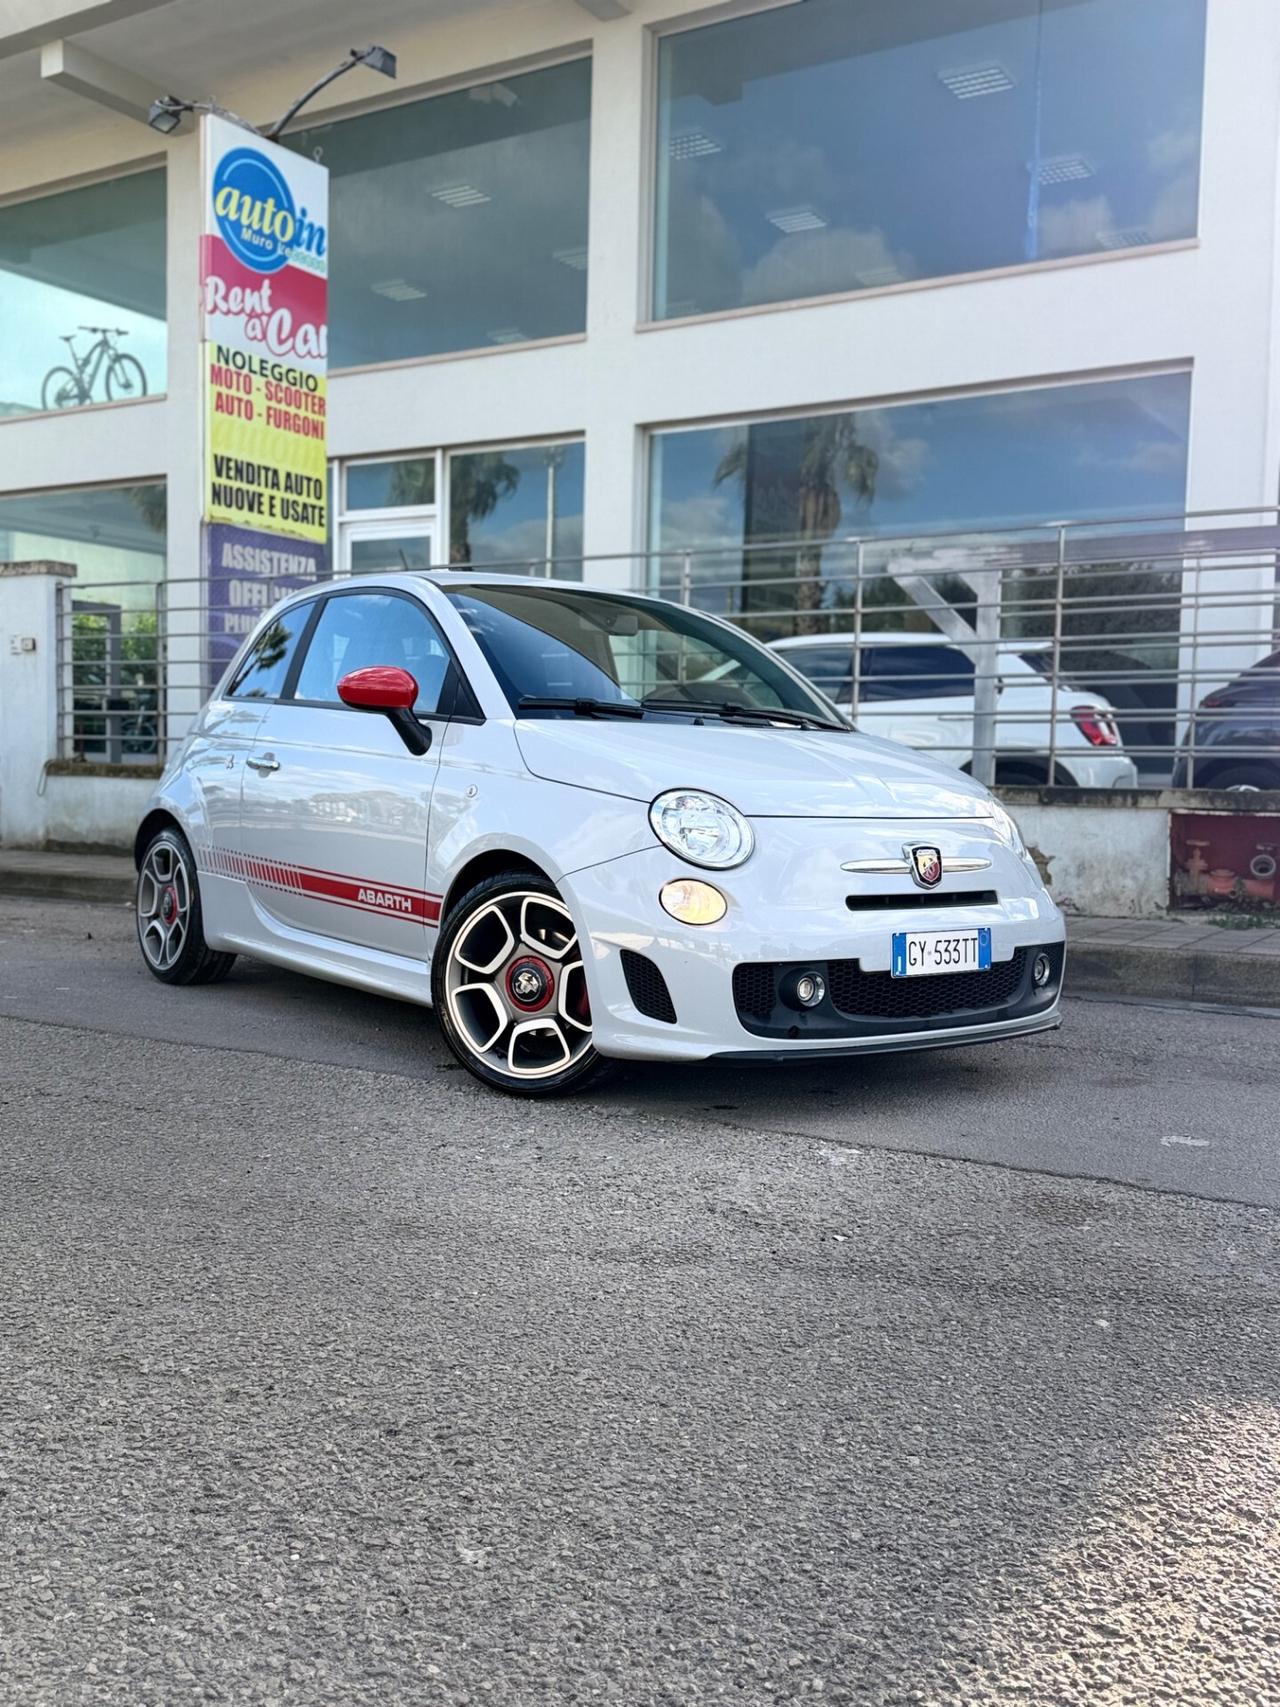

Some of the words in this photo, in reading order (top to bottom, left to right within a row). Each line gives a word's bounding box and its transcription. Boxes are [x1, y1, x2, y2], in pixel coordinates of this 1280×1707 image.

[241, 227, 273, 251] Muro
[206, 276, 272, 314] Rent
[216, 345, 318, 392] NOLEGGIO
[211, 364, 252, 395] MOTO
[265, 381, 326, 418] SCOOTER
[215, 392, 254, 421] AUTO
[266, 408, 325, 440] FURGONI
[213, 454, 281, 491] VENDITA
[284, 471, 322, 500] AUTO
[212, 482, 265, 515] NUOVE
[269, 497, 276, 517] E
[281, 500, 326, 528] USATE
[222, 542, 317, 582] ASSISTENZA
[358, 889, 412, 912] ABARTH
[934, 938, 978, 965] 533TT
